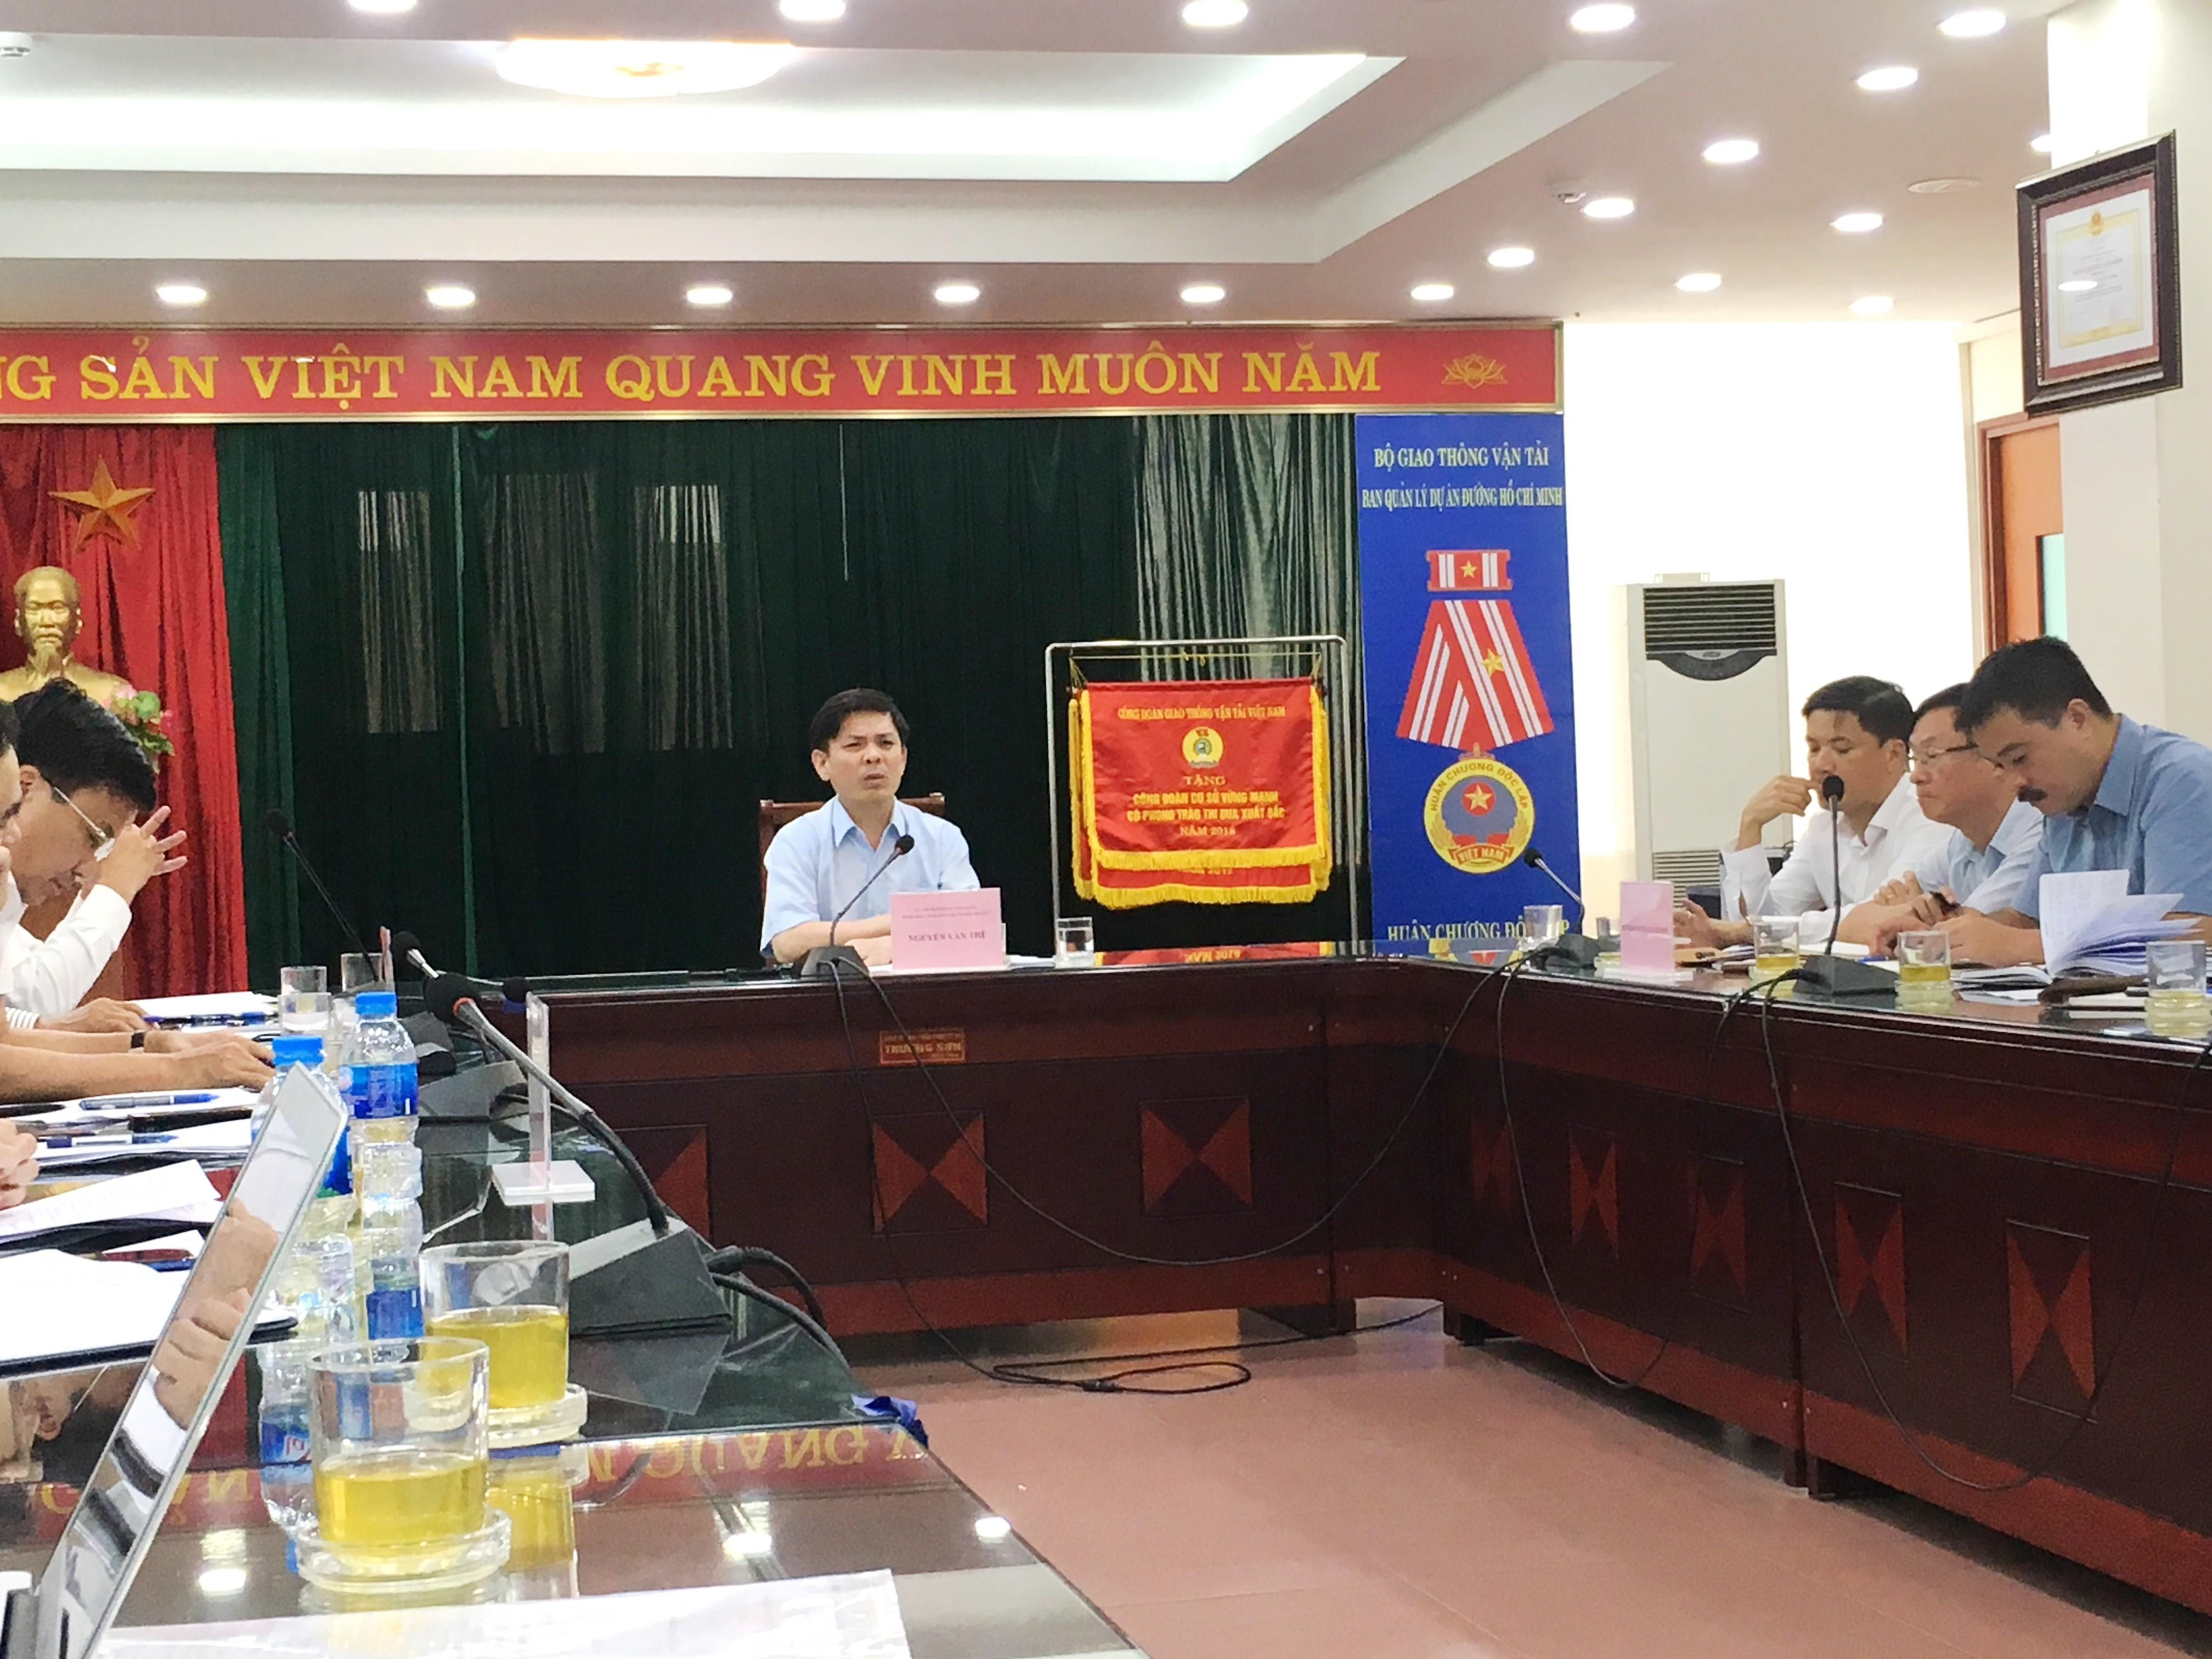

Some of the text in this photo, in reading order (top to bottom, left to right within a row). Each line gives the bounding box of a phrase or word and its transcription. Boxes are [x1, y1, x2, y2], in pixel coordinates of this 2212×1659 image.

[0, 336, 1381, 410] G SẢN VIỆT NAM QUANG VINH MUÔN NĂM
[1374, 440, 1549, 472] BỘ GIAO THÔNG VẬN TẢI
[1362, 489, 1383, 507] BAN
[1536, 487, 1562, 506] MINH
[1387, 919, 1431, 941] HUÂN
